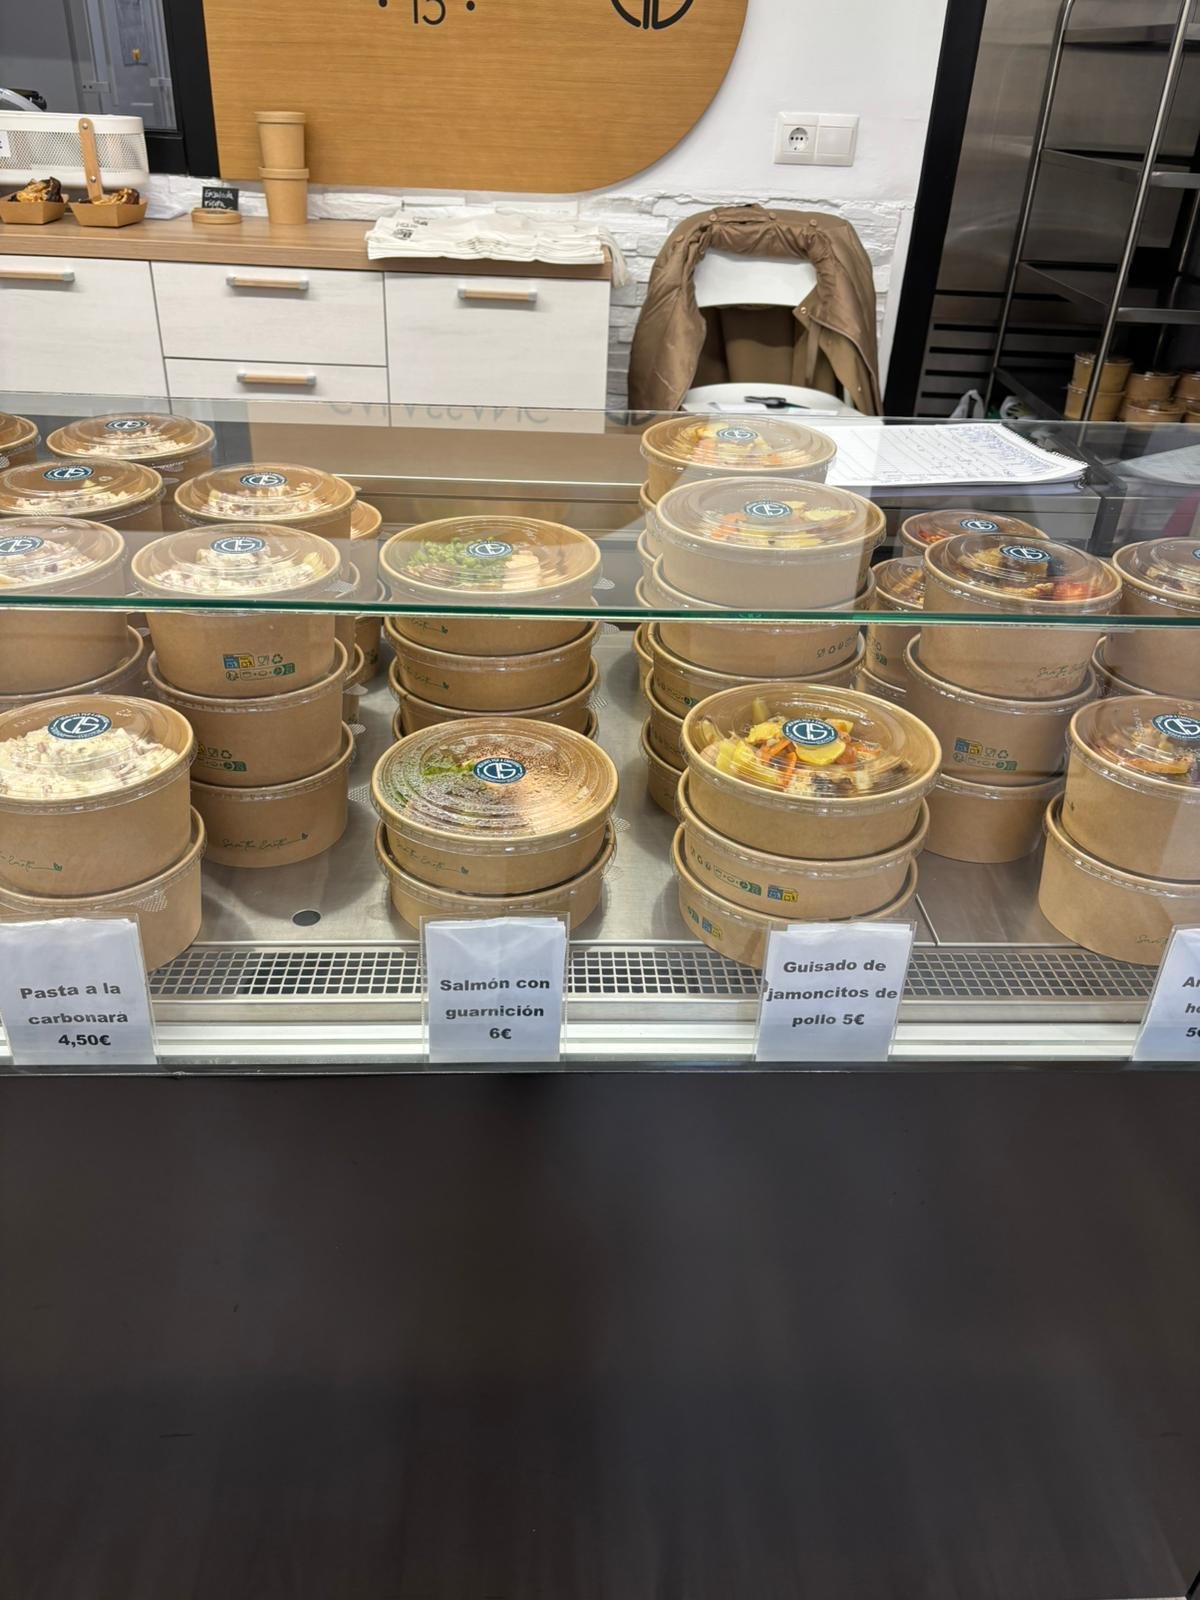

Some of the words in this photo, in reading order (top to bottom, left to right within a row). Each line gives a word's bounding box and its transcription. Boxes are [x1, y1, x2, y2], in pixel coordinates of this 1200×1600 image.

[783, 960, 857, 973] Guisado
[863, 960, 887, 971] de
[20, 985, 79, 999] Pasta
[86, 985, 97, 995] a
[103, 983, 121, 995] la
[440, 978, 510, 991] Salmón
[516, 979, 550, 989] con
[766, 987, 869, 1001] jamoncitos
[875, 988, 898, 998] de
[446, 1005, 544, 1020] guarnición
[792, 1014, 836, 1027] pollo
[842, 1014, 865, 1025] 5€
[489, 1028, 512, 1039] 6€
[58, 1034, 111, 1048] 4,50€
